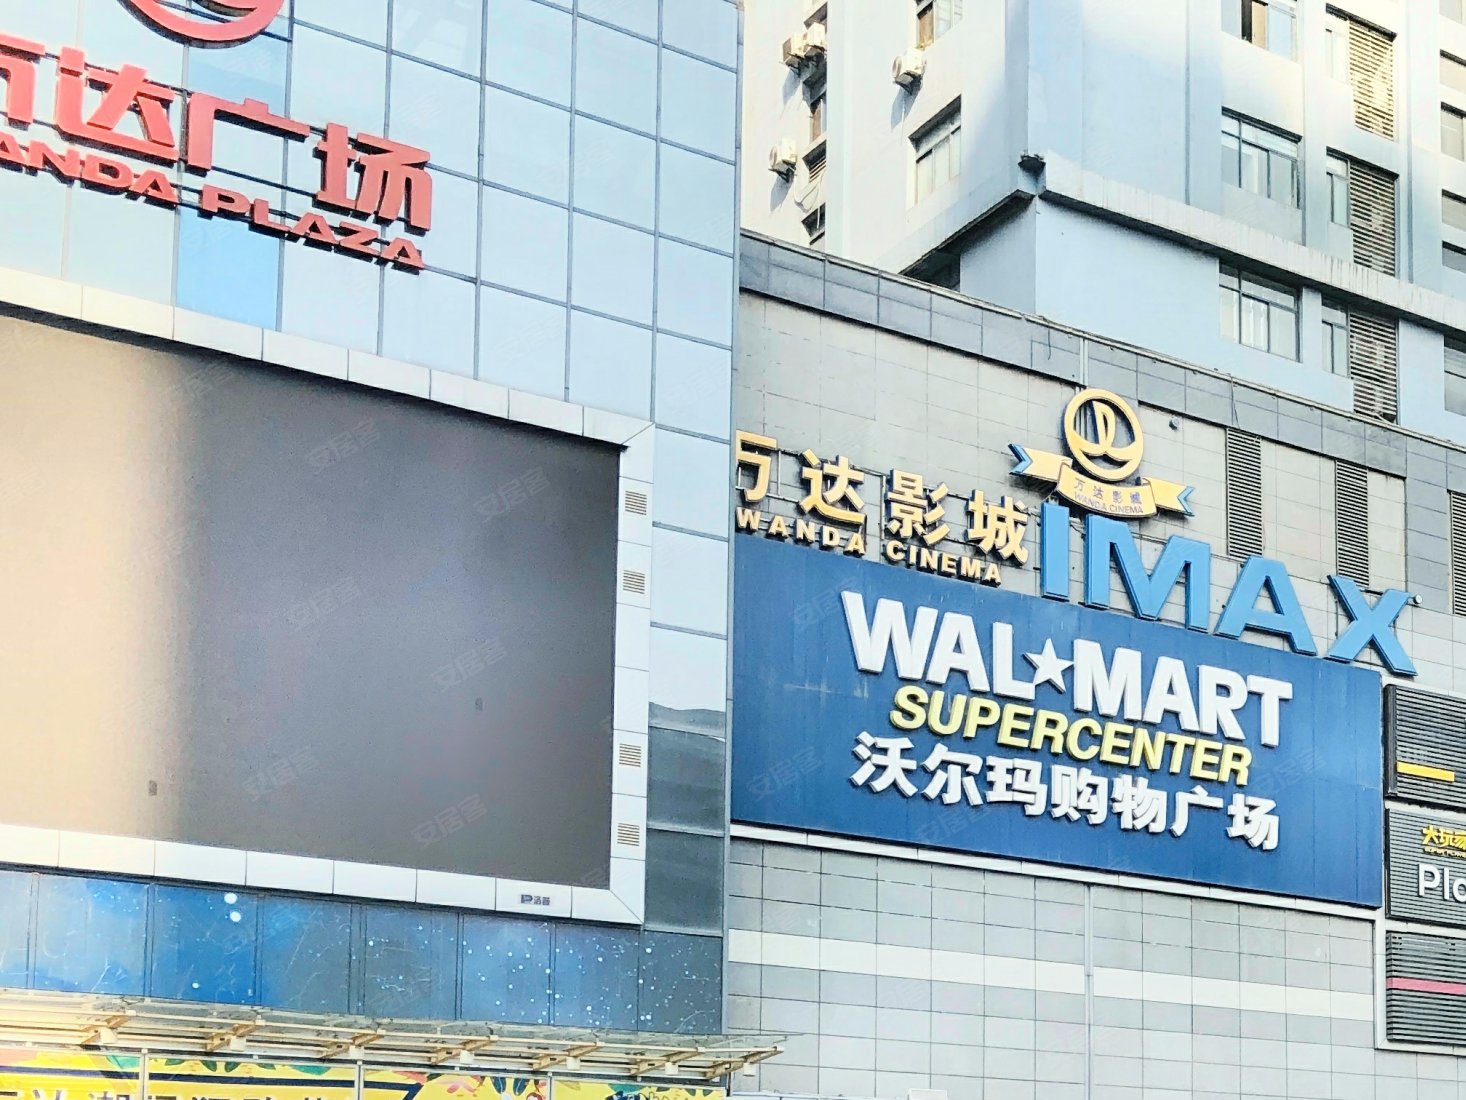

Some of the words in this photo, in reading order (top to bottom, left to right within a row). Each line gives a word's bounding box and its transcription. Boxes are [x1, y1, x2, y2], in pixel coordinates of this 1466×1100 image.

[202, 184, 425, 269] PLAZA
[736, 506, 866, 556] WANDA
[884, 540, 1001, 587] CINEMA
[1075, 491, 1107, 511] WANDA
[1109, 504, 1143, 513] CINEMA
[1040, 502, 1417, 676] IMAX
[890, 685, 1252, 786] SUPERCENTER
[849, 731, 1280, 851] 沃尔玛购物广场
